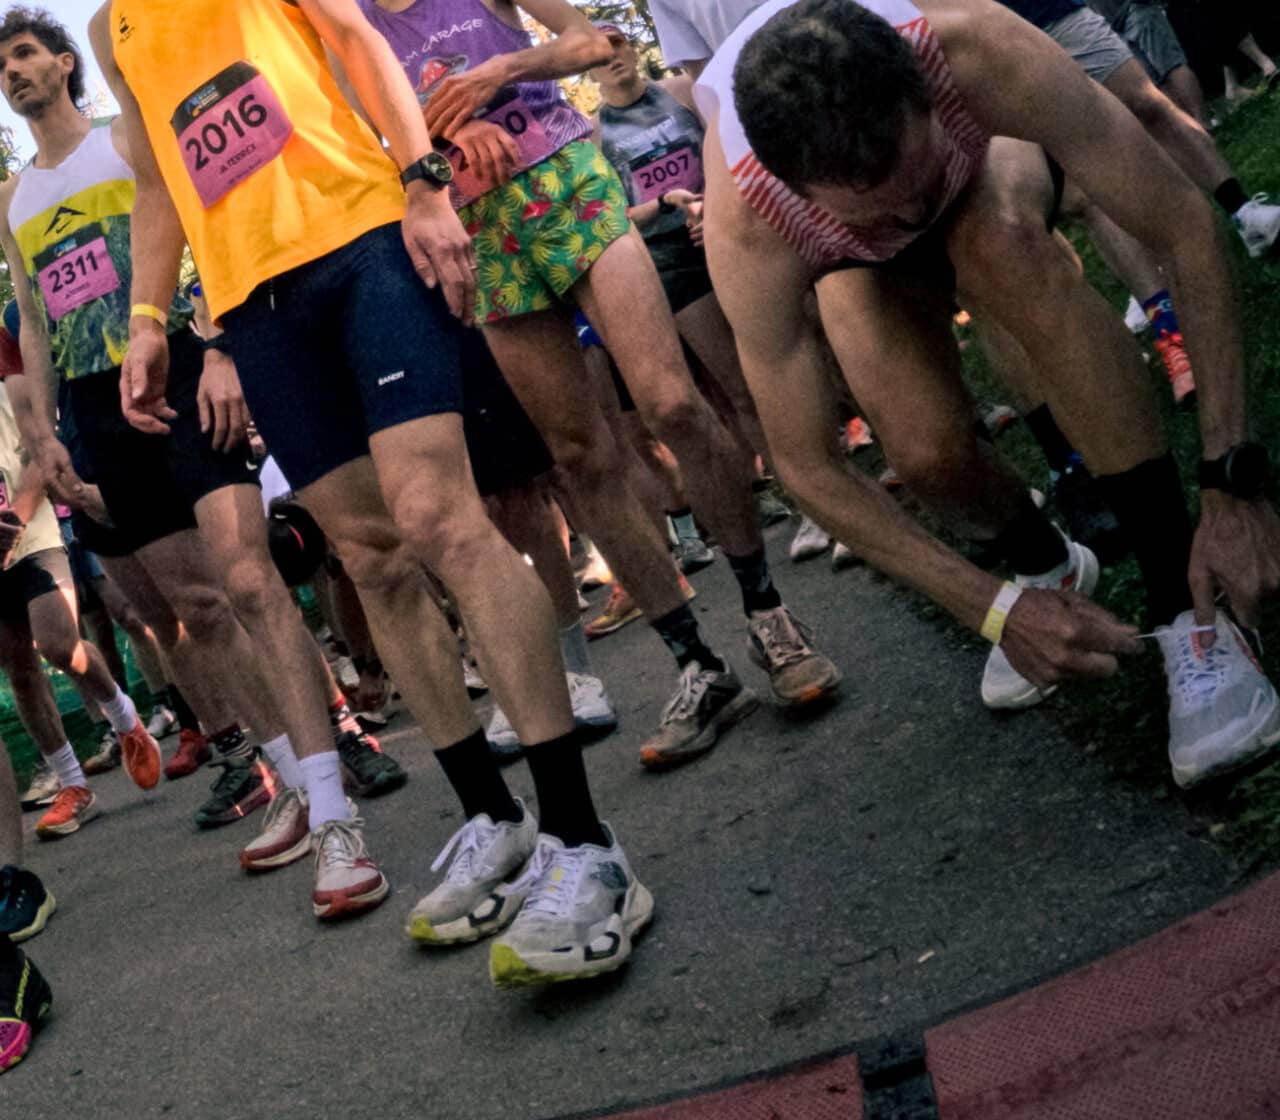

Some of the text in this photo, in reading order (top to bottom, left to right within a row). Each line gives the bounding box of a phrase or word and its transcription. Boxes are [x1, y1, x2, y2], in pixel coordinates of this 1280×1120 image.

[185, 93, 267, 171] 2016
[640, 154, 689, 189] 2007
[48, 250, 99, 293] 2311
